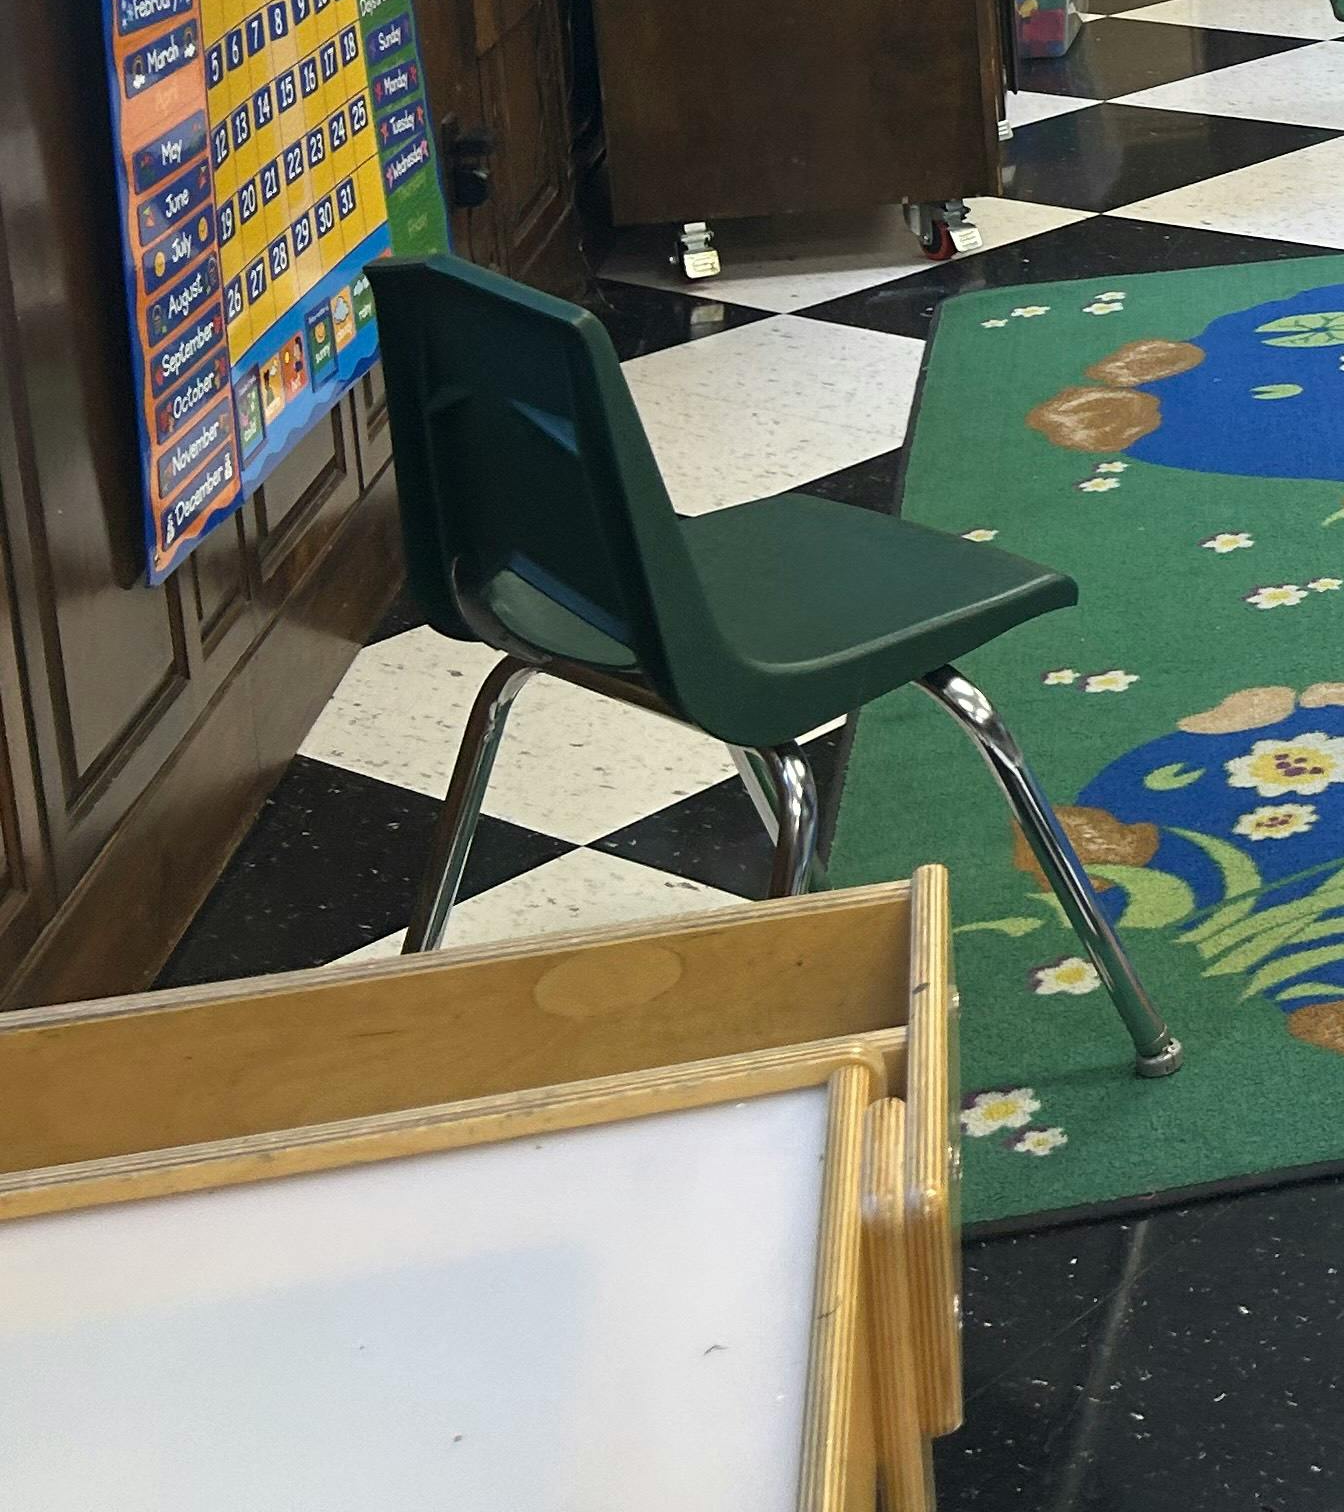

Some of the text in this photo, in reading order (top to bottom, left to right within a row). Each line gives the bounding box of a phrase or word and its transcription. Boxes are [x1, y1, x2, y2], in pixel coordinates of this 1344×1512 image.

[147, 35, 179, 73] March
[210, 51, 219, 83] 5
[231, 36, 240, 64] 6
[251, 20, 258, 49] 7
[274, 8, 283, 35] 8
[378, 24, 402, 52] Sunday
[214, 31, 356, 163] 12 13 14 15 16 17 18
[384, 69, 409, 95] Monday
[389, 110, 415, 135] Tuesday
[161, 139, 182, 165] May
[220, 100, 366, 241] 19 20 21 22 23 24 25
[390, 145, 424, 179] Wednesday
[165, 188, 189, 218] June
[172, 232, 193, 264] July
[227, 184, 354, 318] 26 27 28 29 30 31
[168, 272, 205, 320] August
[161, 320, 215, 379] September
[315, 342, 331, 364] sunny
[173, 370, 215, 420] October
[172, 419, 219, 477] November
[174, 465, 224, 529] December
